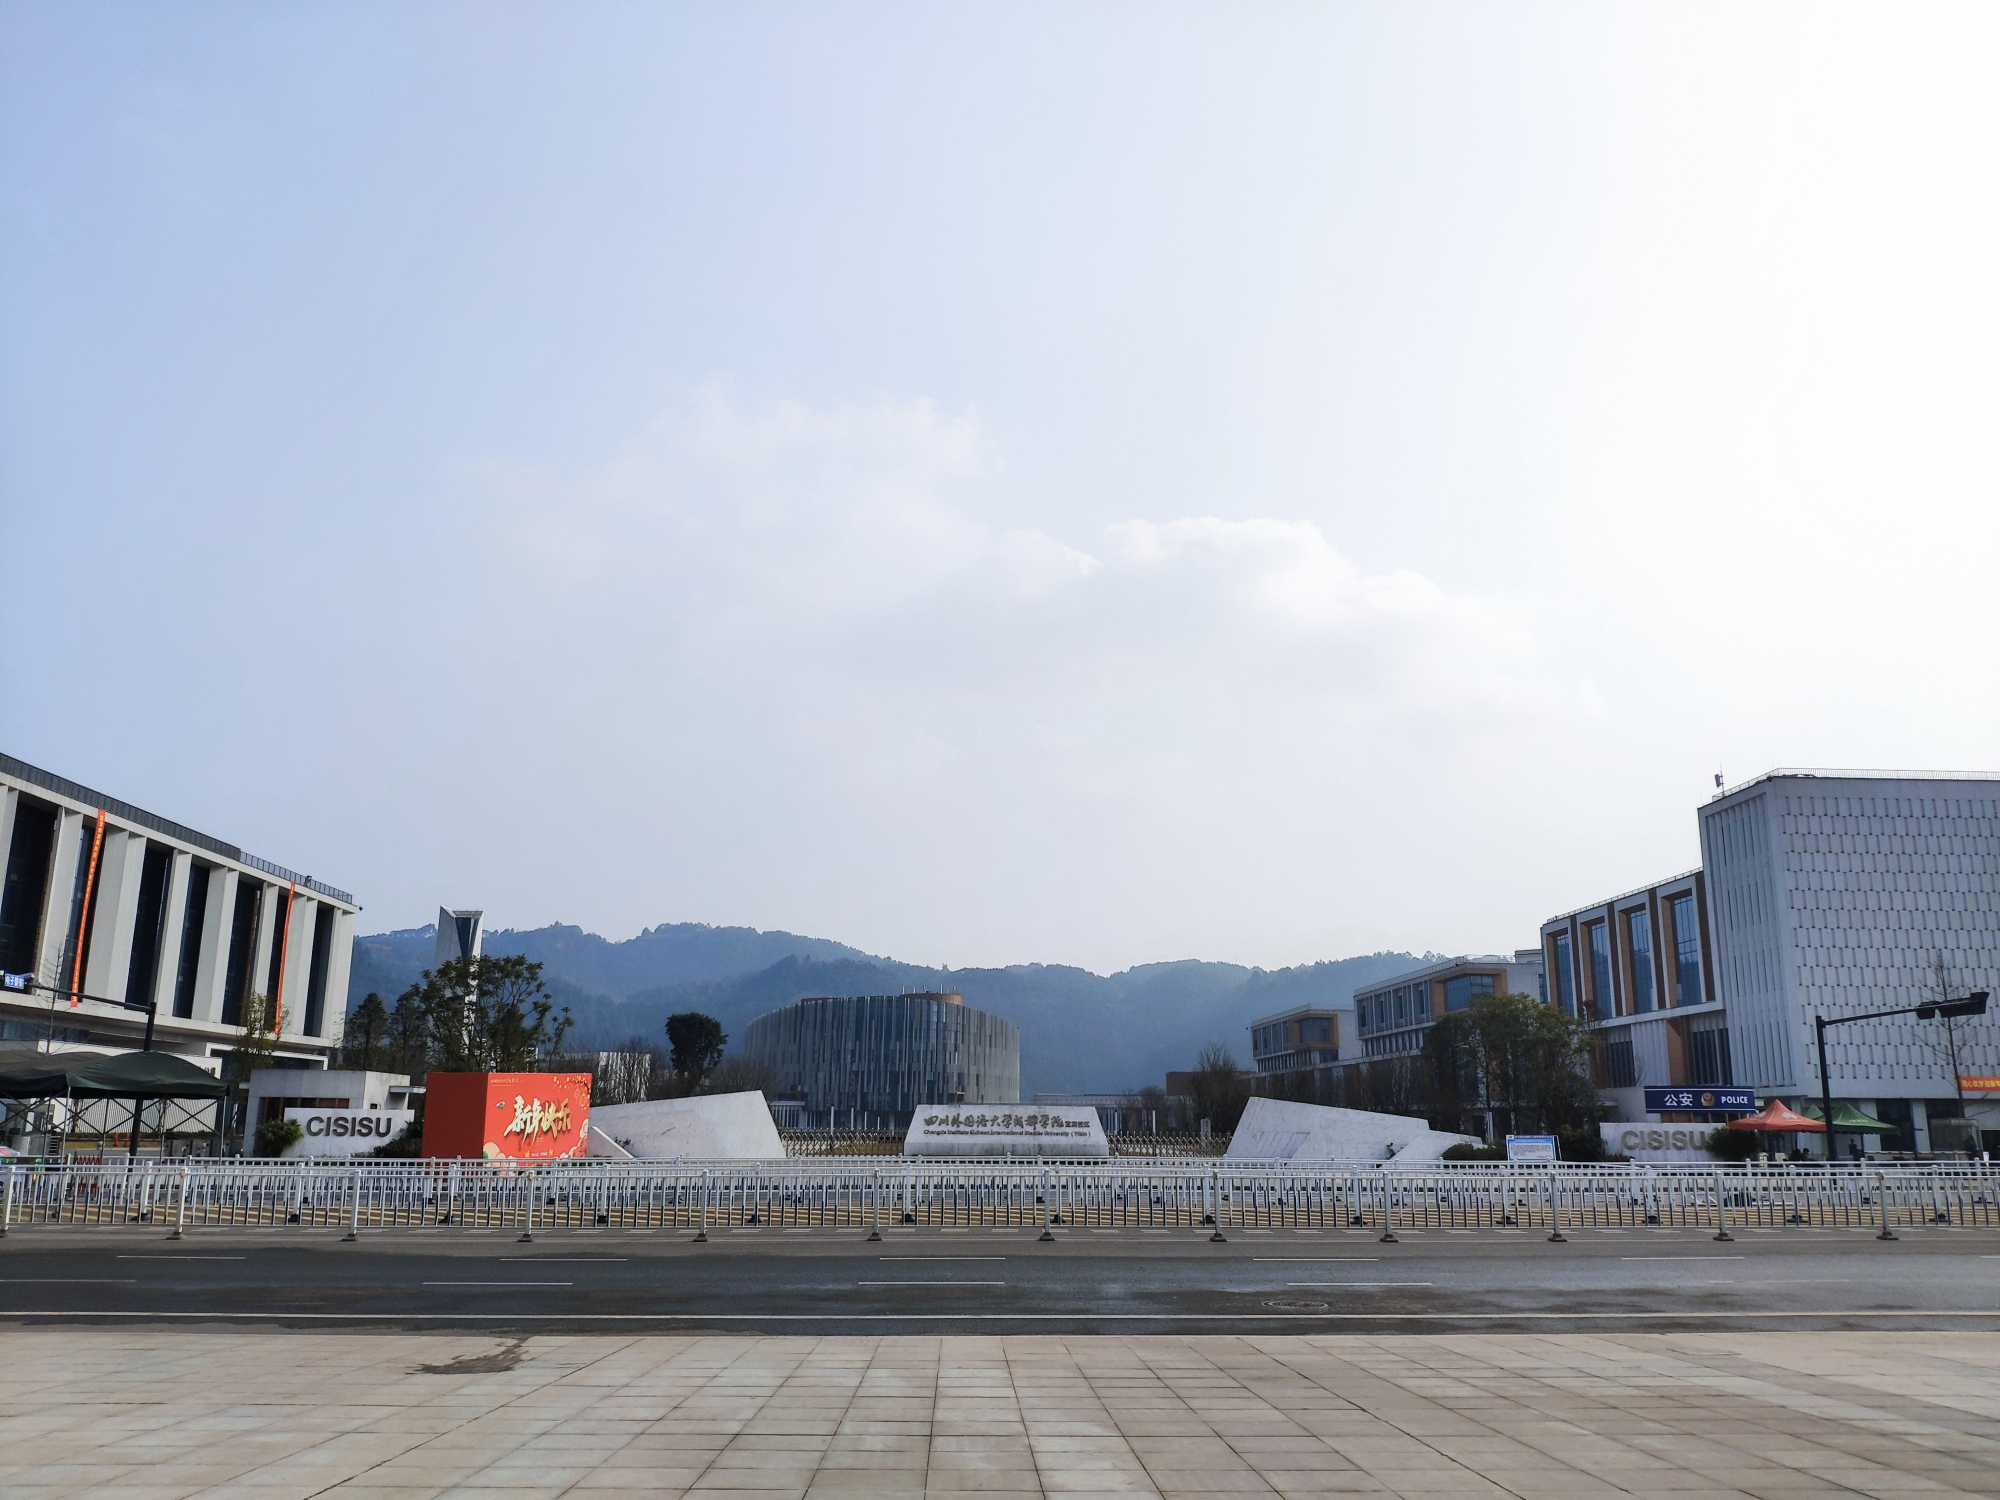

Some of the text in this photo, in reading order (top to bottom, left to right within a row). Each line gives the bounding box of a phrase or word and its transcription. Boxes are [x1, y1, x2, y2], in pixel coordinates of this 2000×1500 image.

[1664, 1092, 1693, 1106] 公安
[1721, 1096, 1748, 1104] POLICE
[306, 1116, 392, 1137] CISISU
[503, 1094, 572, 1147] 新年快乐
[924, 1112, 1064, 1130] 四川外国语大学成都学院
[1621, 1130, 1706, 1150] CISISU
